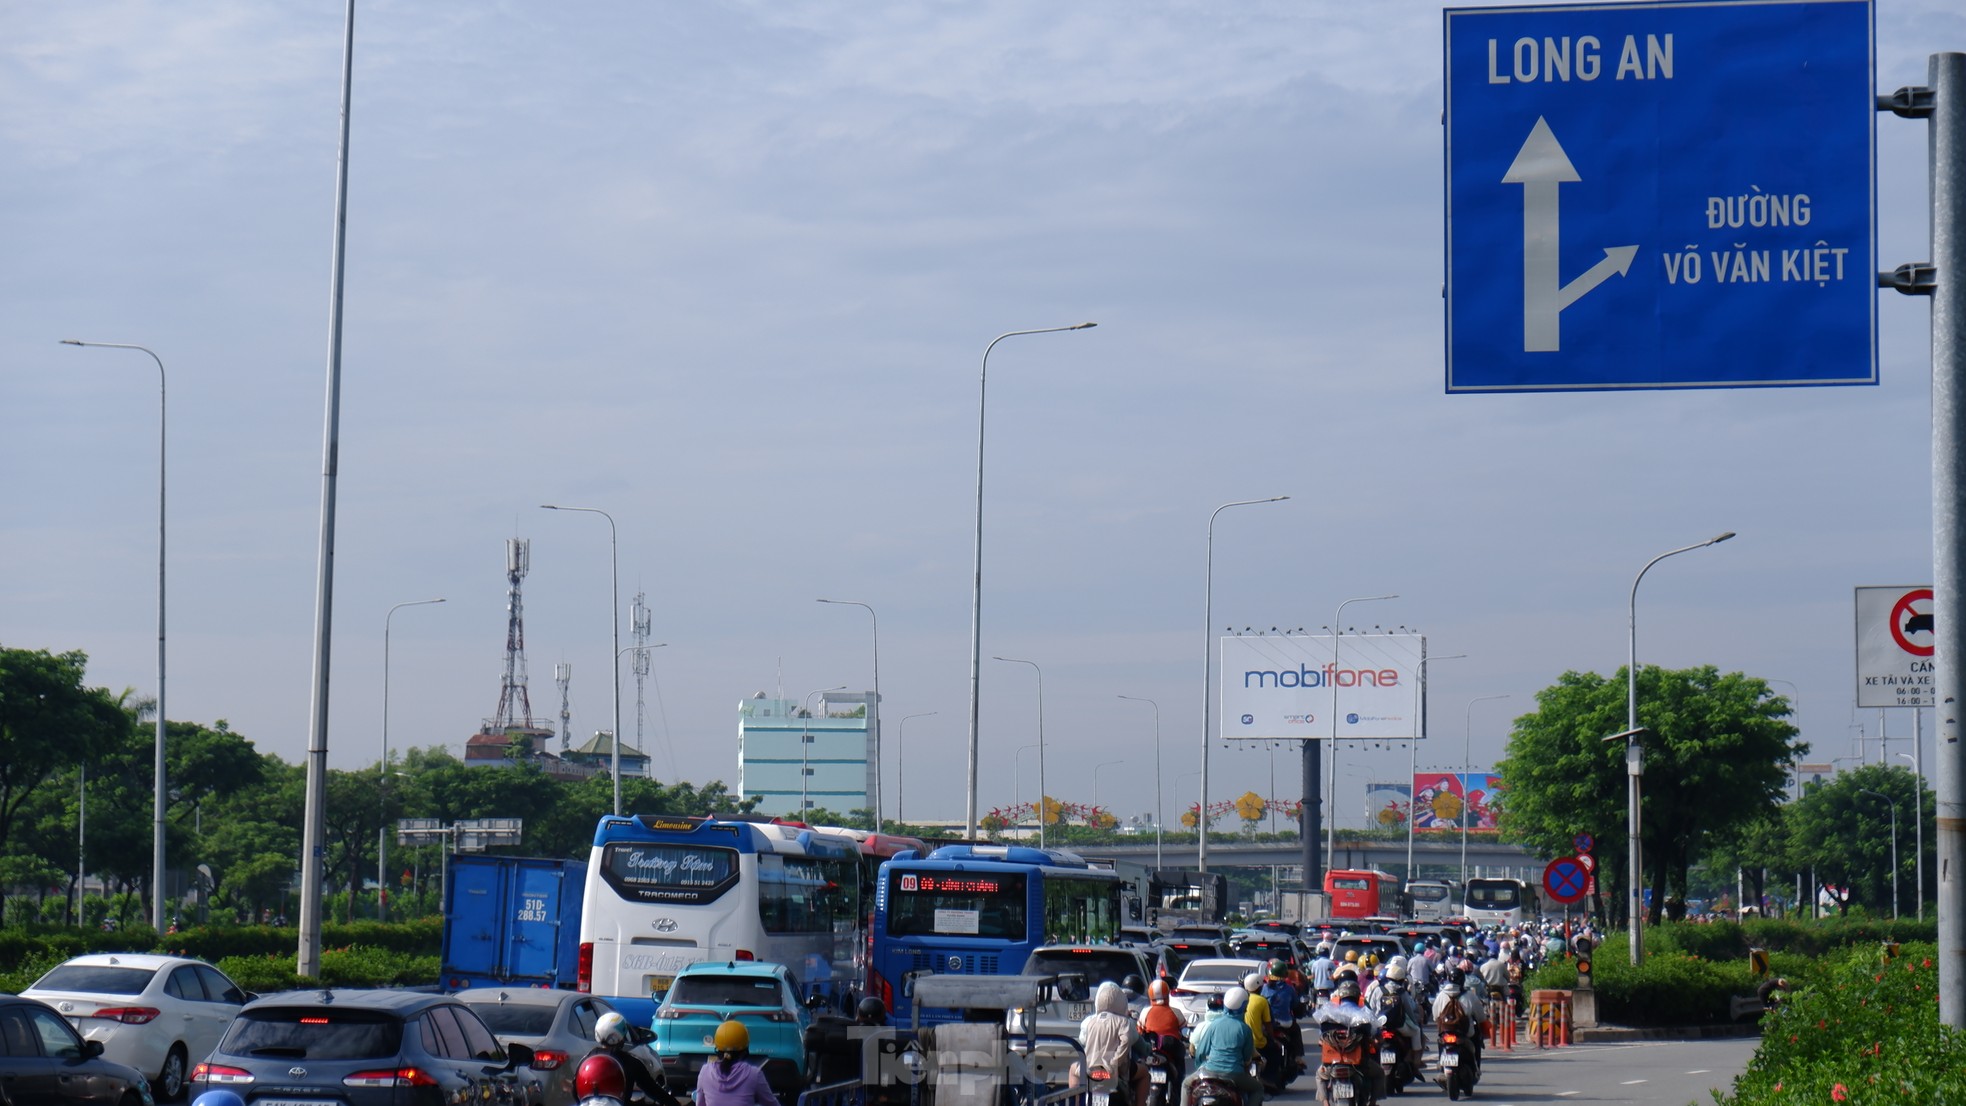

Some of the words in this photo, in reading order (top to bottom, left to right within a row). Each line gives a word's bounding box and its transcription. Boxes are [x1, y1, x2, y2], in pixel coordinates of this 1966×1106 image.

[1488, 36, 1601, 84] LONG
[1616, 33, 1674, 80] AN
[1706, 185, 1811, 229] ĐƯỜNG
[1663, 244, 1701, 285] VÕ
[1712, 242, 1770, 283] VĂN
[1783, 240, 1849, 288] KIỆT
[1245, 662, 1398, 688] mobifone
[1865, 676, 1879, 685] XE
[1901, 674, 1914, 685] VÀ
[1917, 676, 1930, 685] XE
[1896, 687, 1920, 695] 06:00
[1897, 697, 1920, 705] 16:00
[653, 820, 692, 830] Limousine
[903, 877, 915, 888] 09
[638, 890, 698, 899] TRACOMECO
[525, 899, 545, 910] 51D-
